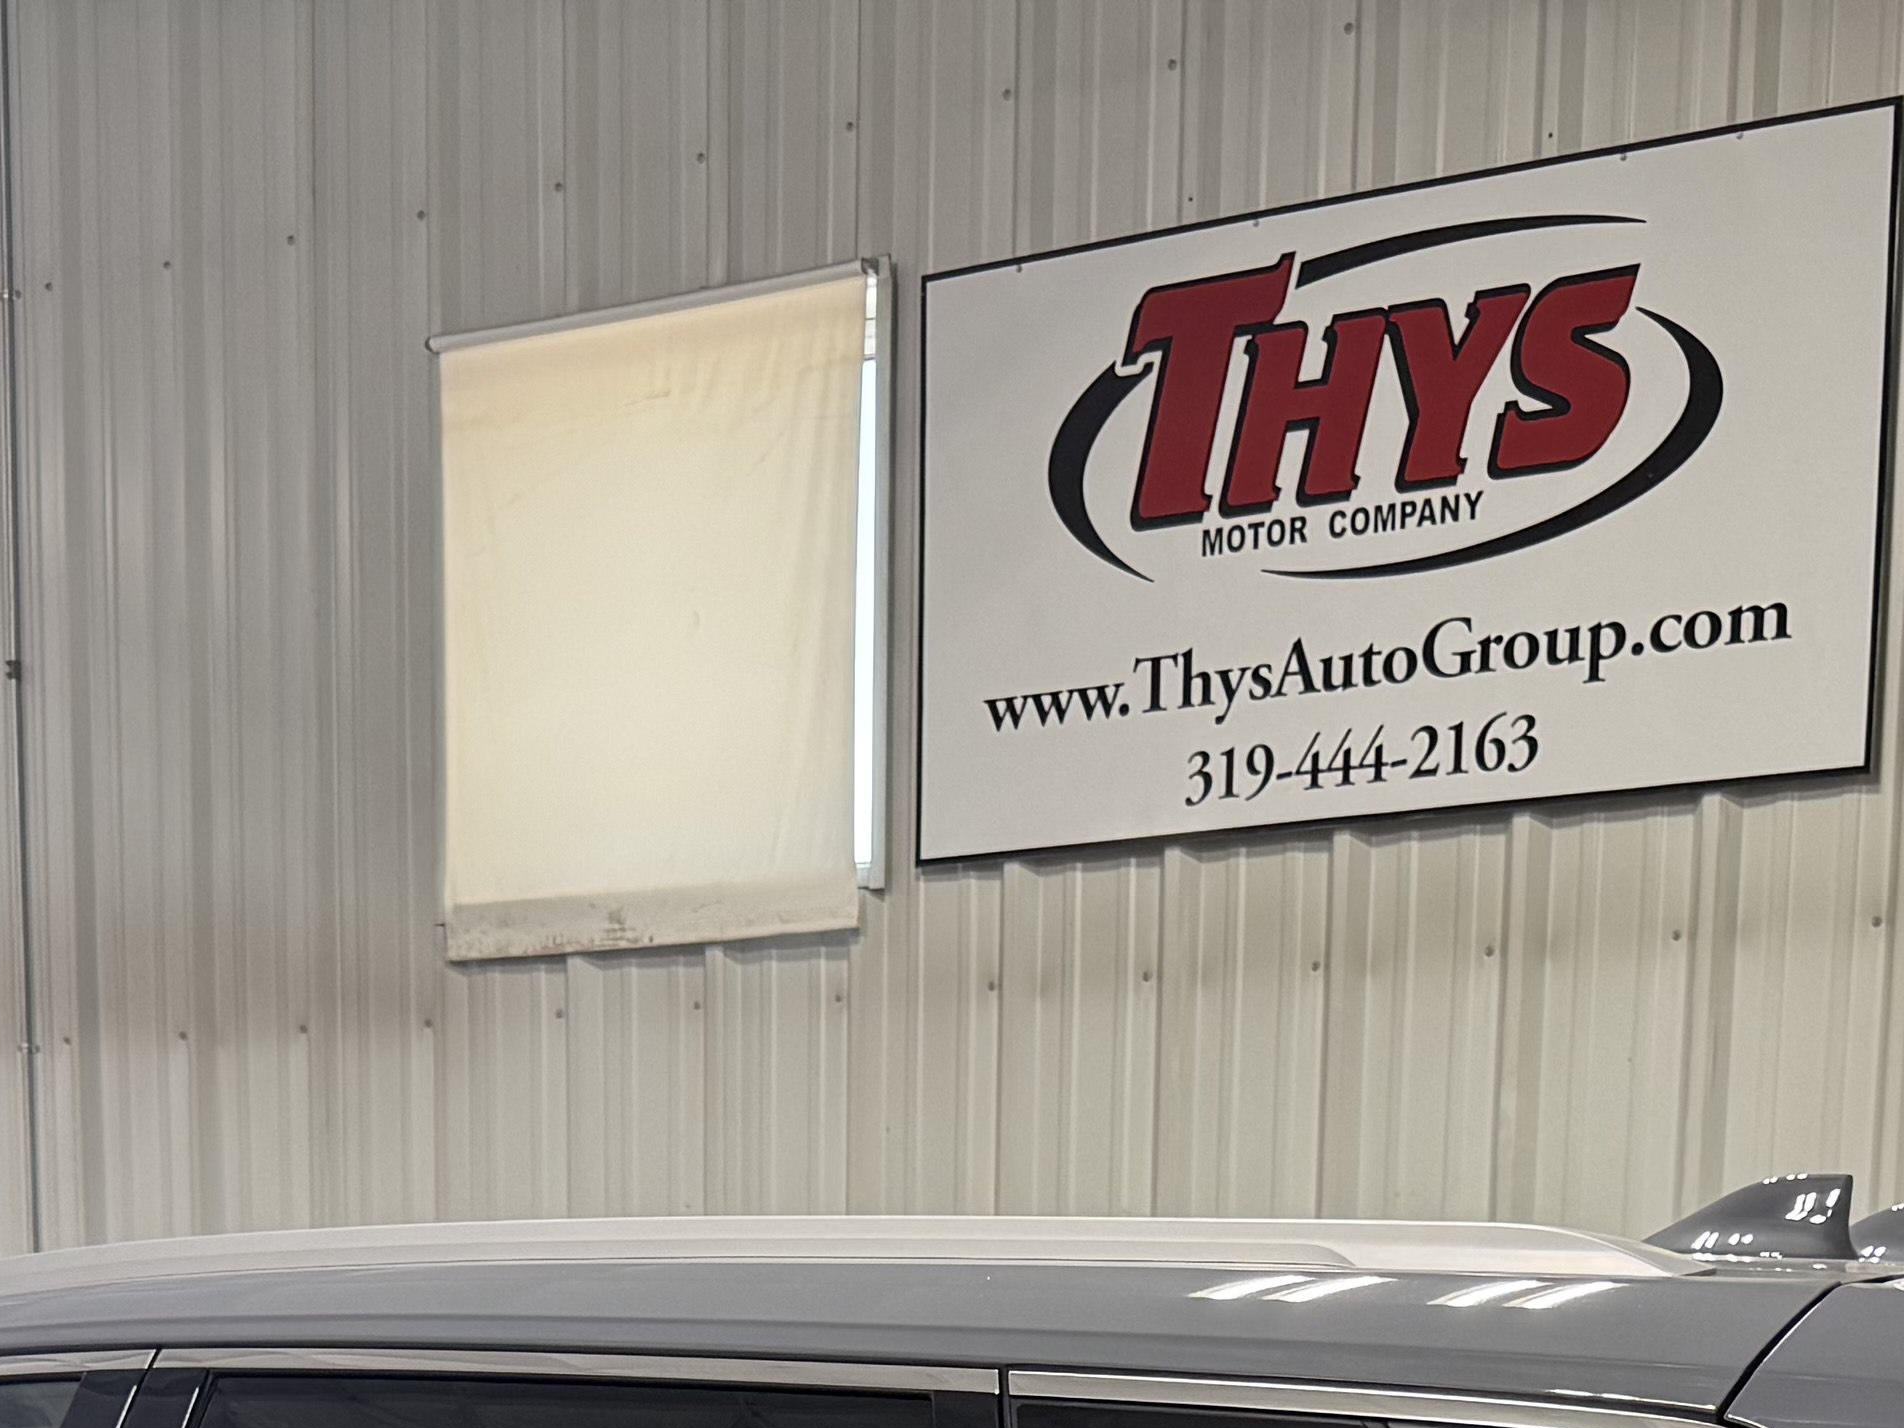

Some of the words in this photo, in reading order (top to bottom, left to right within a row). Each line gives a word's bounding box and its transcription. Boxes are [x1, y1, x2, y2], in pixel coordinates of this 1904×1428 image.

[1121, 250, 1642, 533] THYS
[1201, 515, 1308, 558] MOTOR
[1328, 490, 1485, 539] COMPANY
[983, 602, 1792, 732] www.ThysAutoGroup.com
[1184, 711, 1540, 807] 319-444-2163
